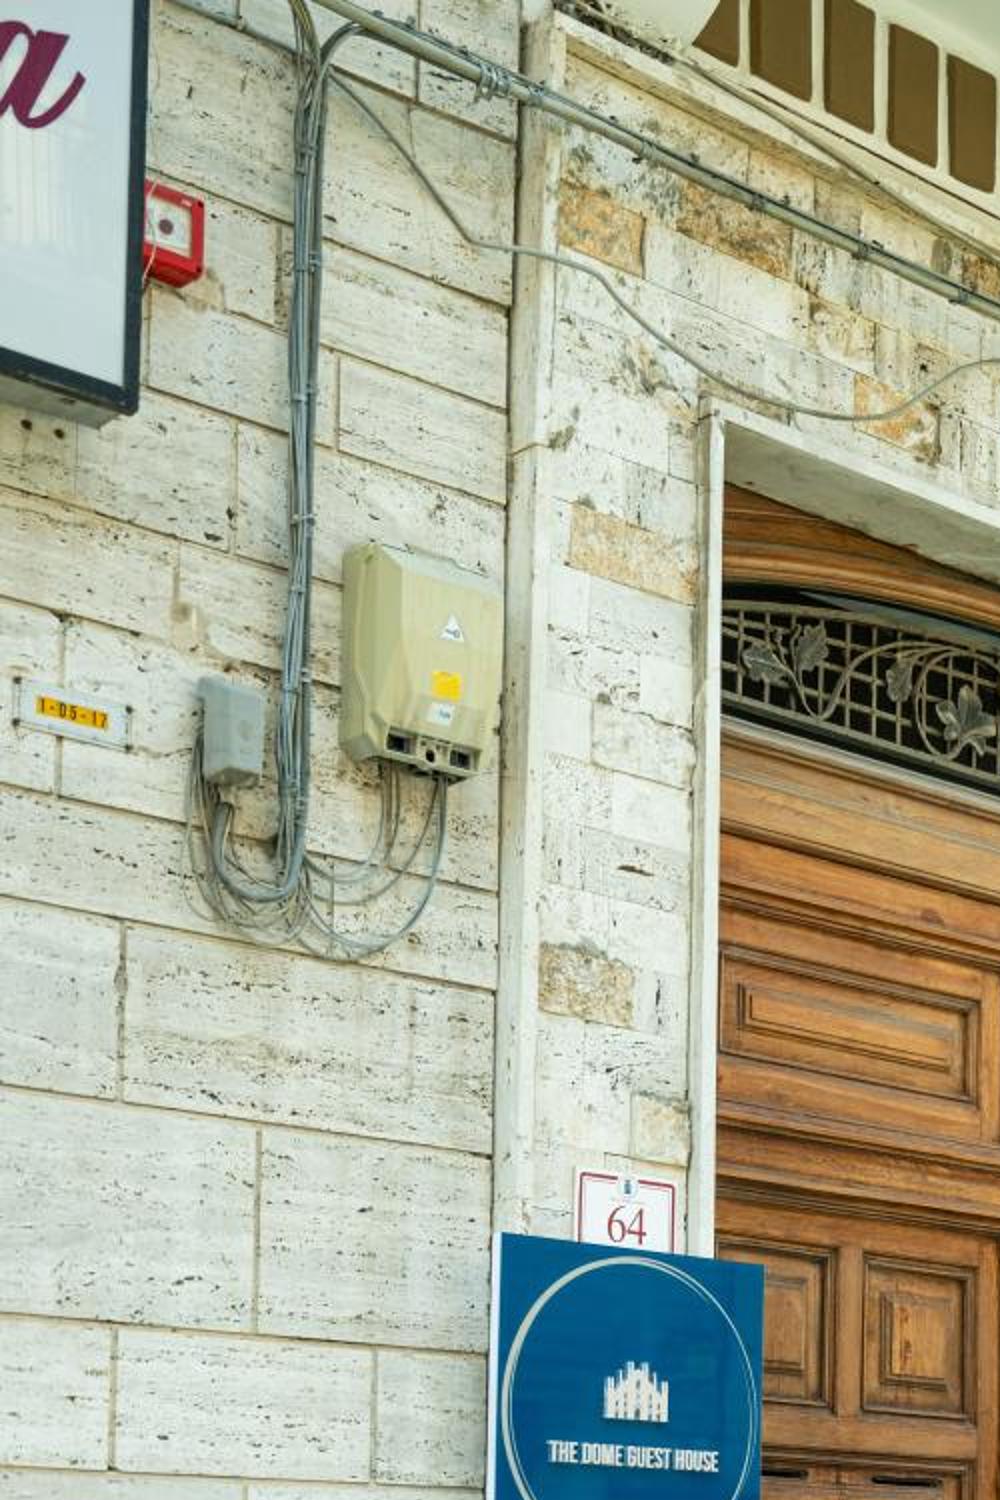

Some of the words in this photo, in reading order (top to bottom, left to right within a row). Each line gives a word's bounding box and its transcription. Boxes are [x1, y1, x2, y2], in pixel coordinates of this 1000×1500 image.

[608, 1205, 647, 1245] 64
[546, 1439, 579, 1463] THE
[580, 1442, 624, 1467] DOME
[626, 1445, 673, 1470] GUEST
[675, 1448, 719, 1473] HOUSE
